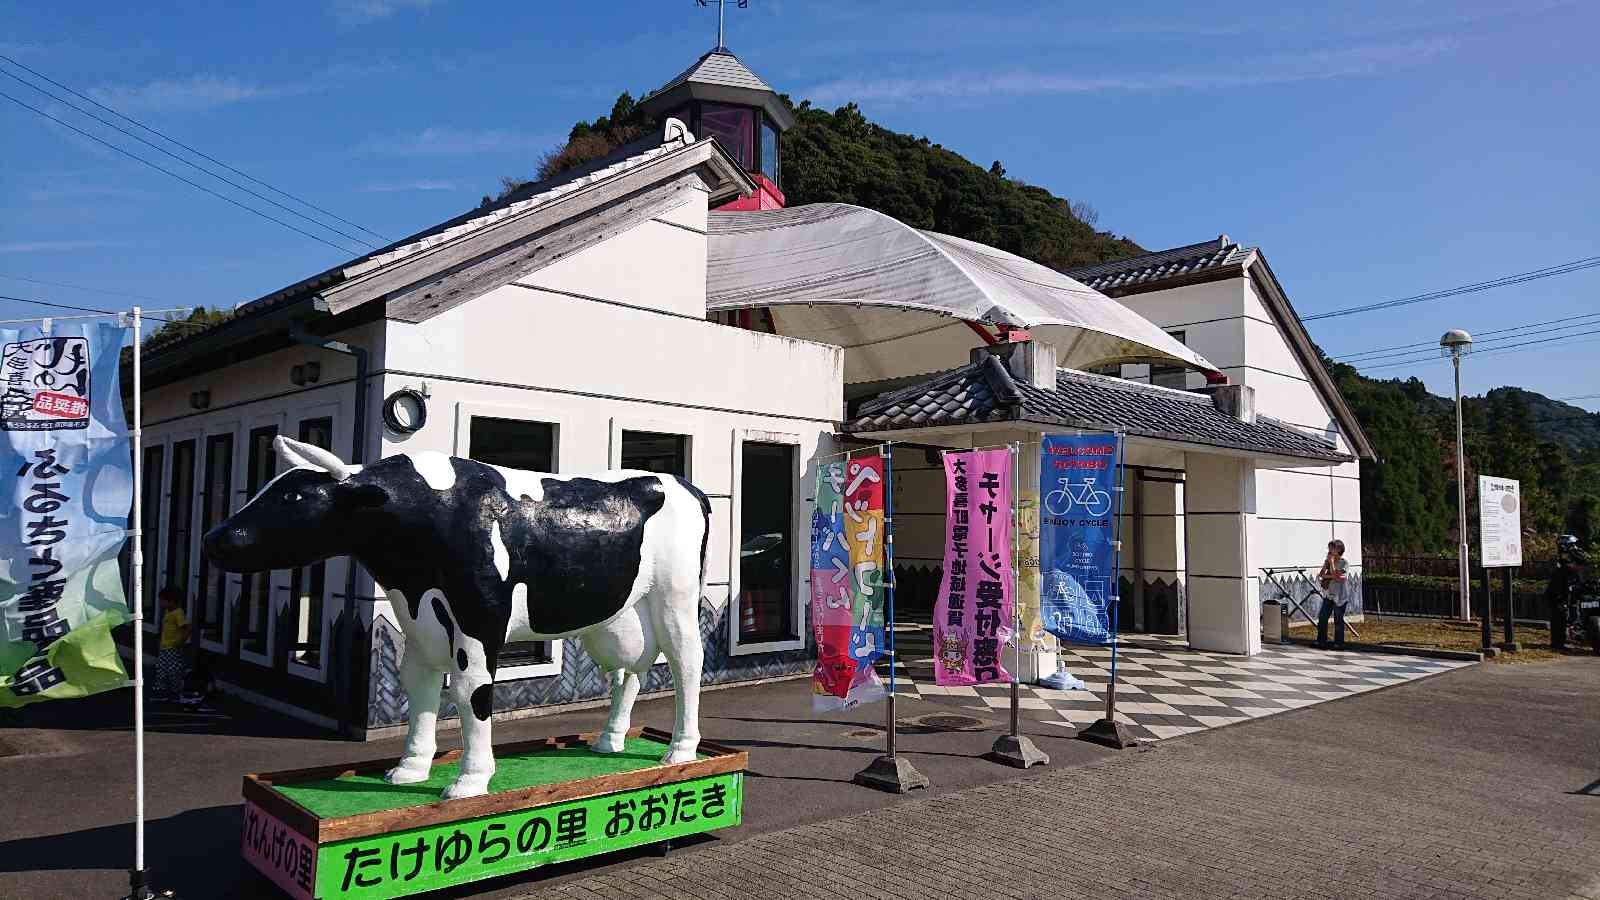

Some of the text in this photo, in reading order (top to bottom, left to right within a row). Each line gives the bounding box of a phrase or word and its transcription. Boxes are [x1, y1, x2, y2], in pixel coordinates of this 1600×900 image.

[1044, 519, 1109, 527] ENJOY CYCLE
[242, 806, 313, 893] れんげの里
[341, 783, 727, 892] たけゆらの里 おおたき
